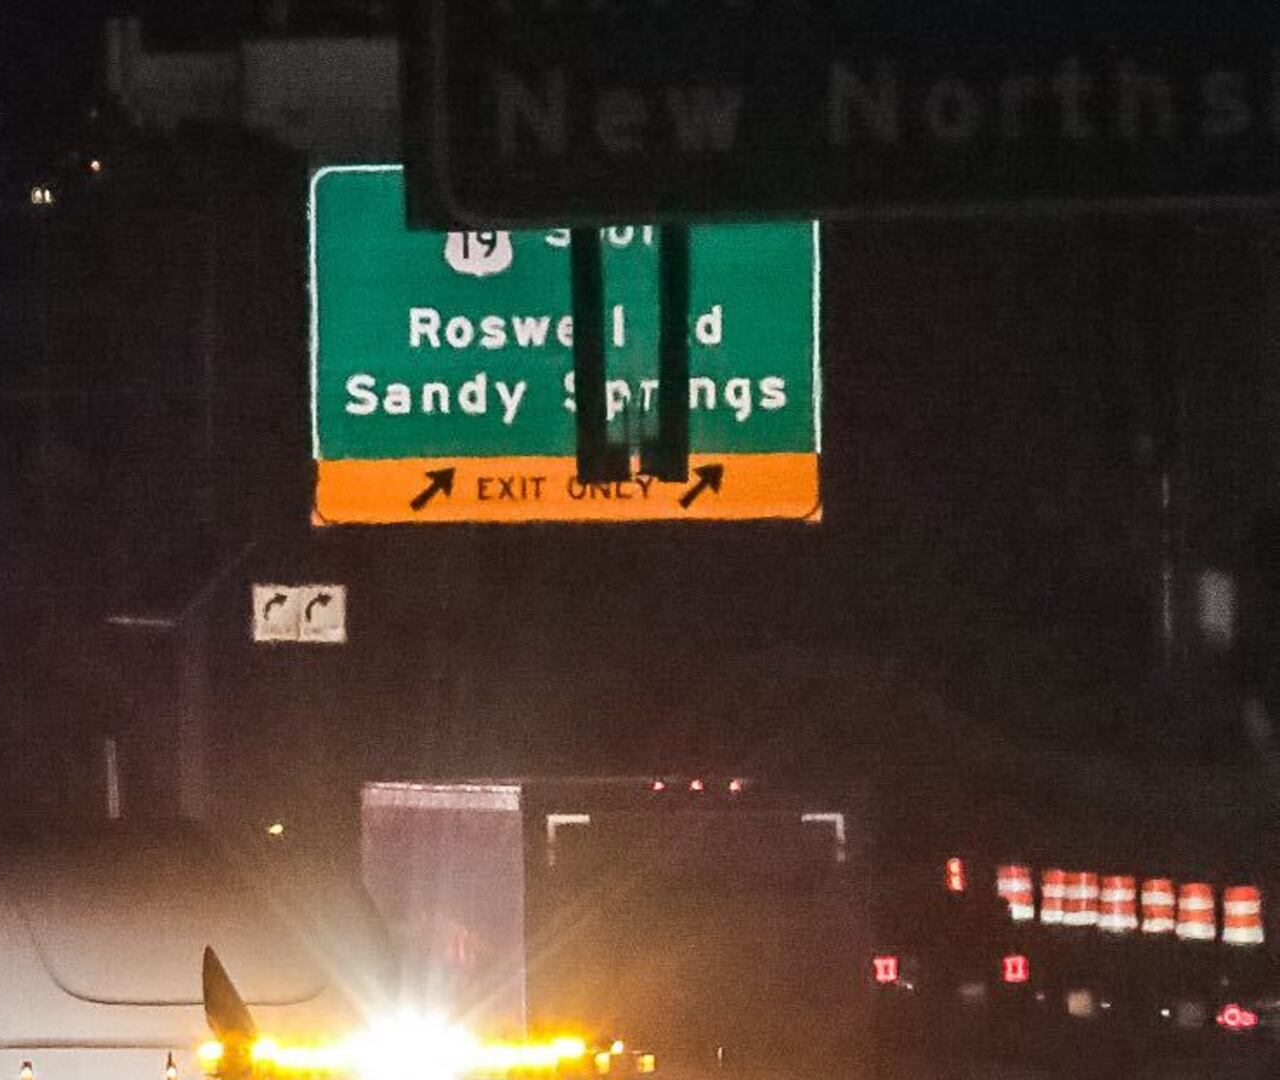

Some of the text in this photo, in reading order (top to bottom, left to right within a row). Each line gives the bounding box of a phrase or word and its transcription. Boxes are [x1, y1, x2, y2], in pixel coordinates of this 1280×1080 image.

[490, 62, 739, 154] New
[462, 232, 497, 259] 19
[408, 305, 625, 349] Roswel
[345, 372, 789, 425] Sandy prngs
[477, 476, 652, 502] EXIT ONLY
